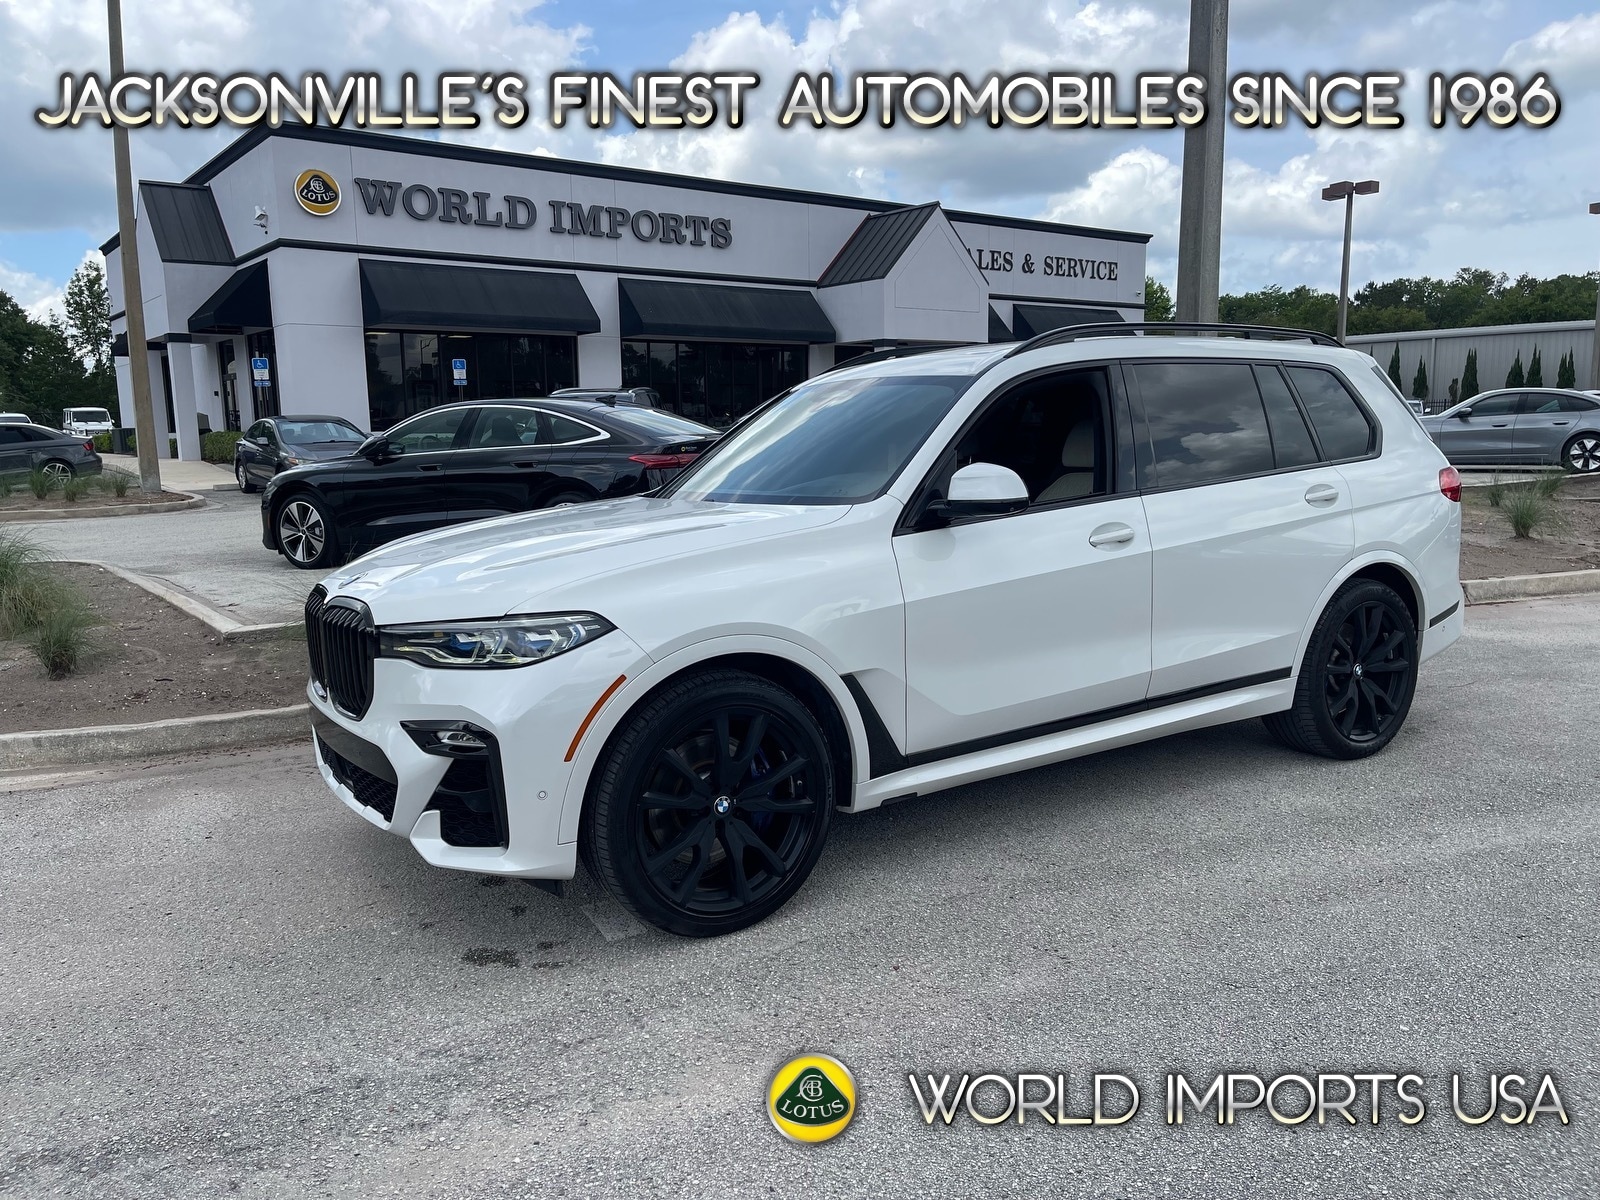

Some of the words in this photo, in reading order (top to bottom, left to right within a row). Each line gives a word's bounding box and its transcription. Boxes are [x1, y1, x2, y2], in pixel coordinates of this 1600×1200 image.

[301, 189, 336, 202] LOTUS
[354, 177, 537, 229] WORLD
[548, 199, 733, 249] IMPORTS
[967, 248, 1013, 272] LES
[1021, 253, 1035, 274] &
[1043, 255, 1118, 281] SERVICE
